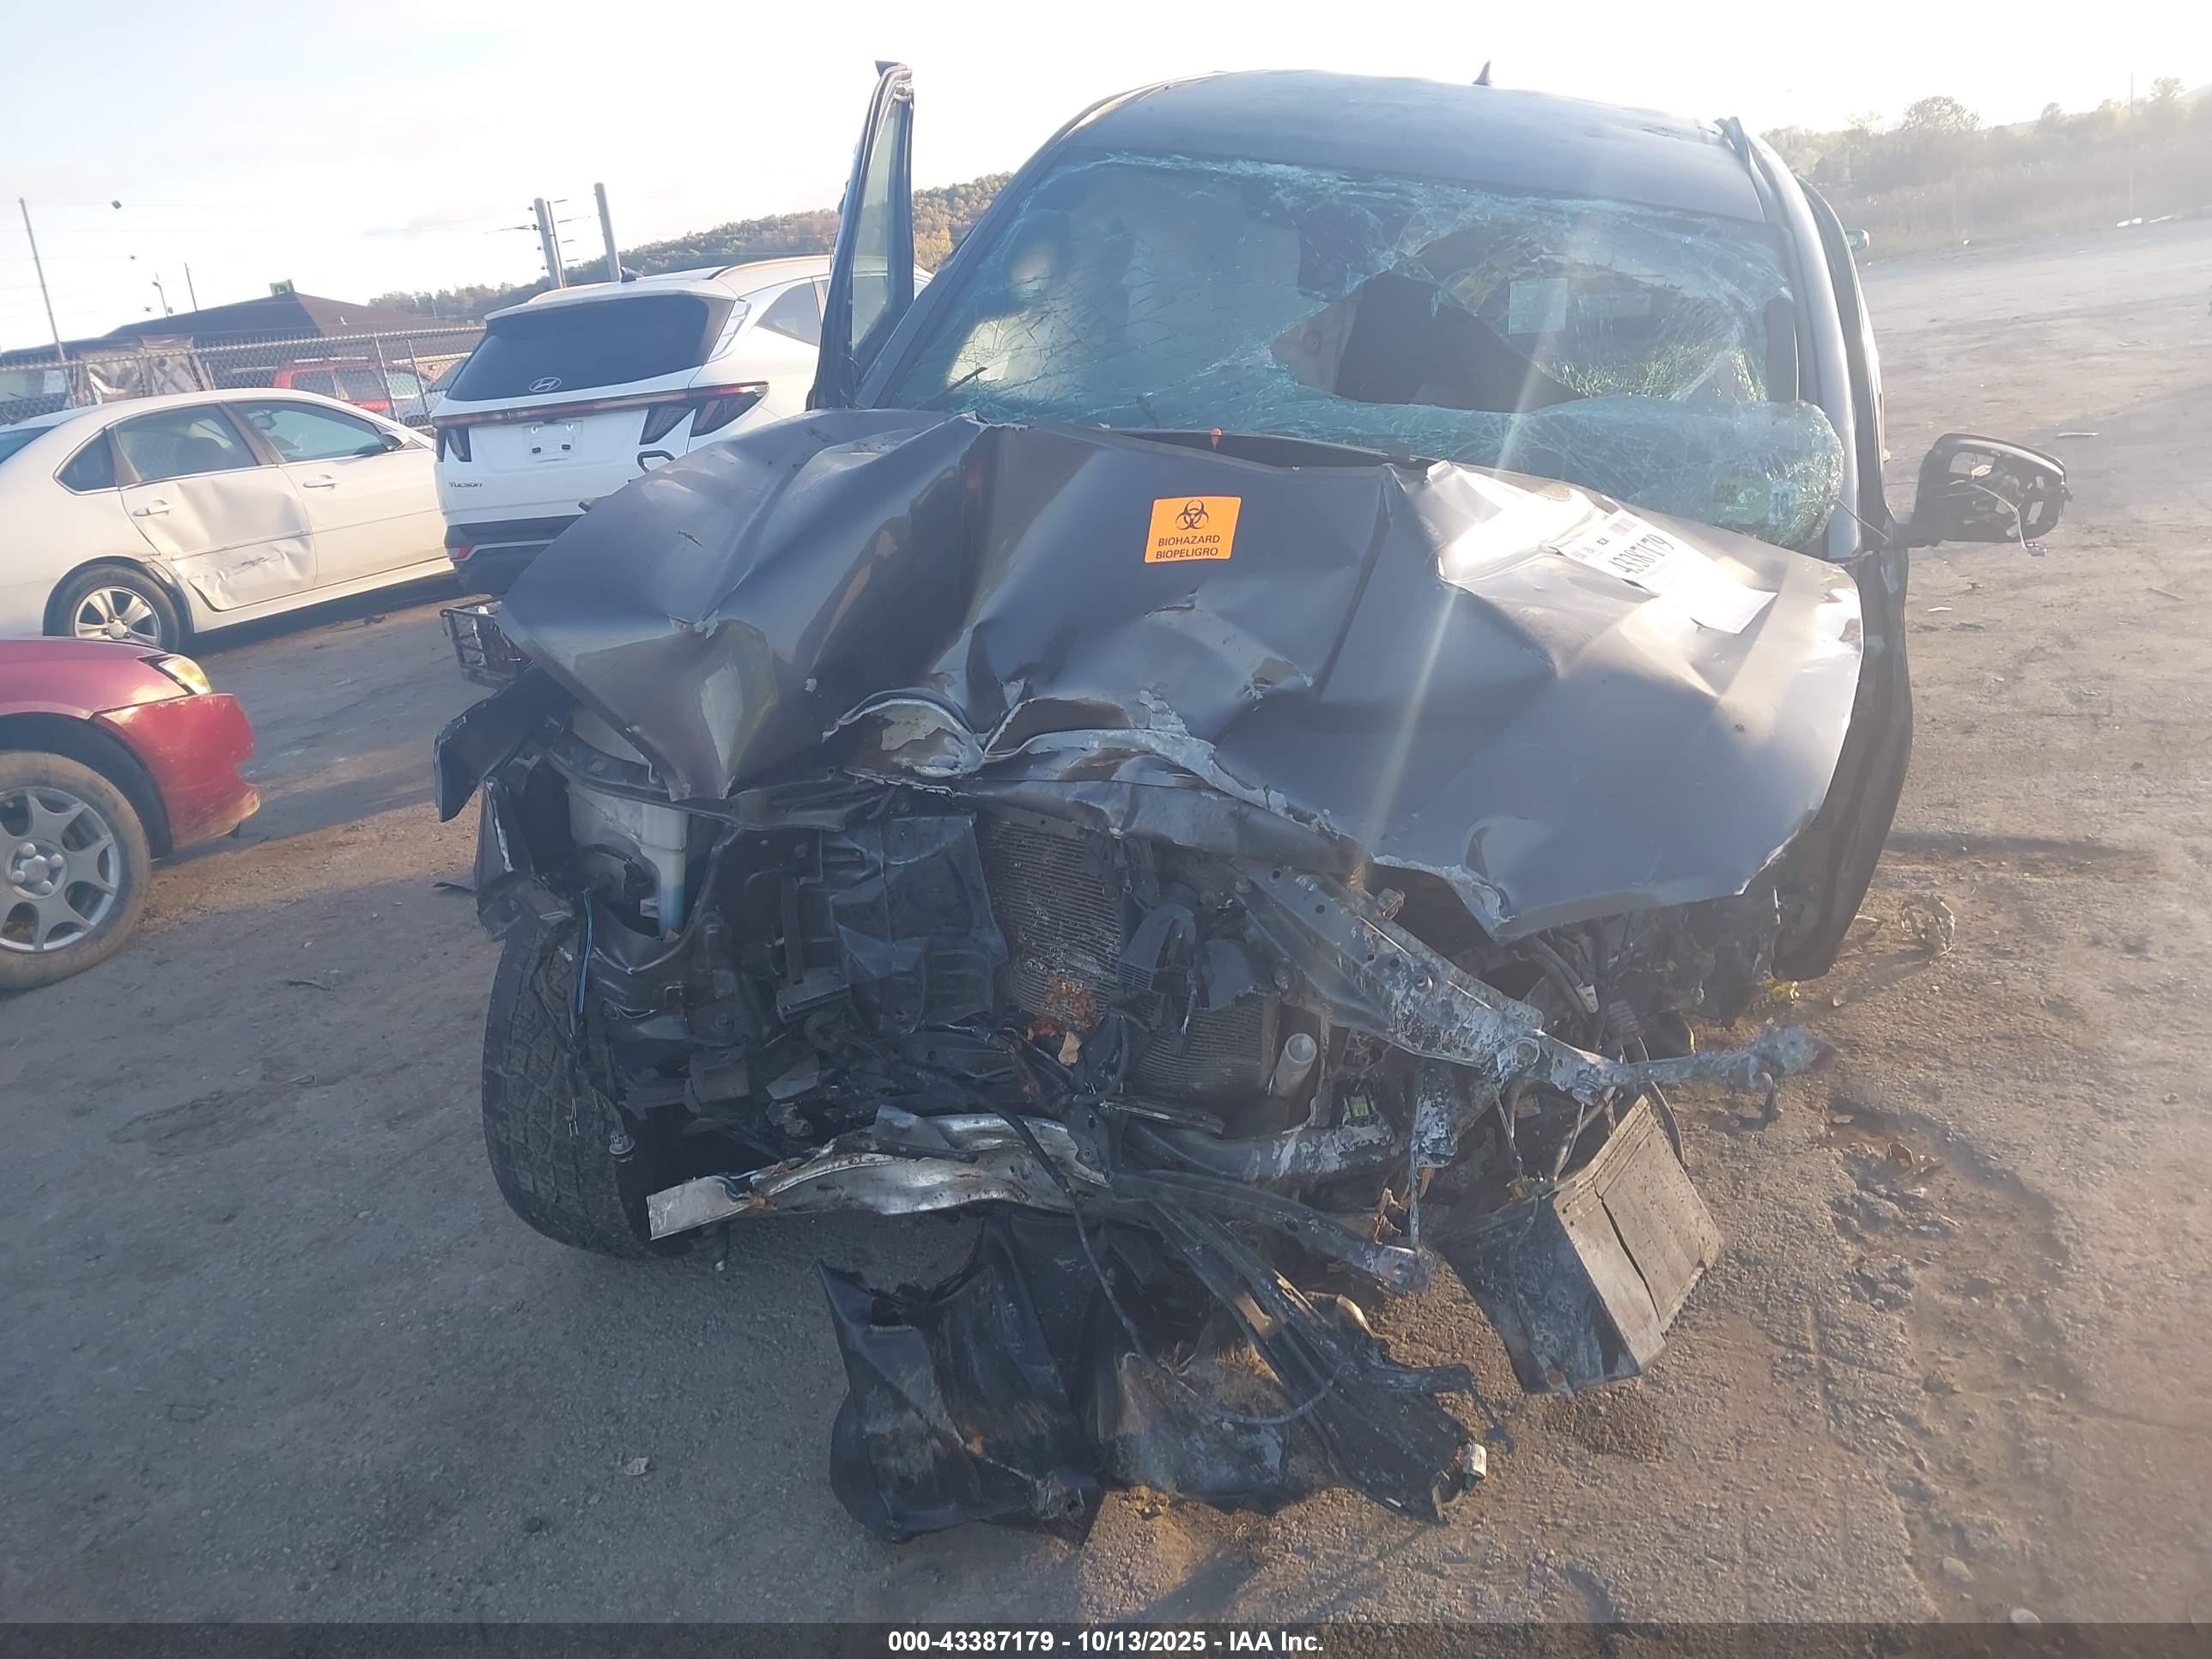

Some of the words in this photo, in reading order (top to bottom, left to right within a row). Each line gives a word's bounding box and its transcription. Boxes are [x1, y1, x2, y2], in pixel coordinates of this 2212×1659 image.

[1158, 535, 1220, 547] BIOHAZARD
[1156, 547, 1218, 559] BIOPELIGRO
[1607, 533, 1674, 574] 43387179
